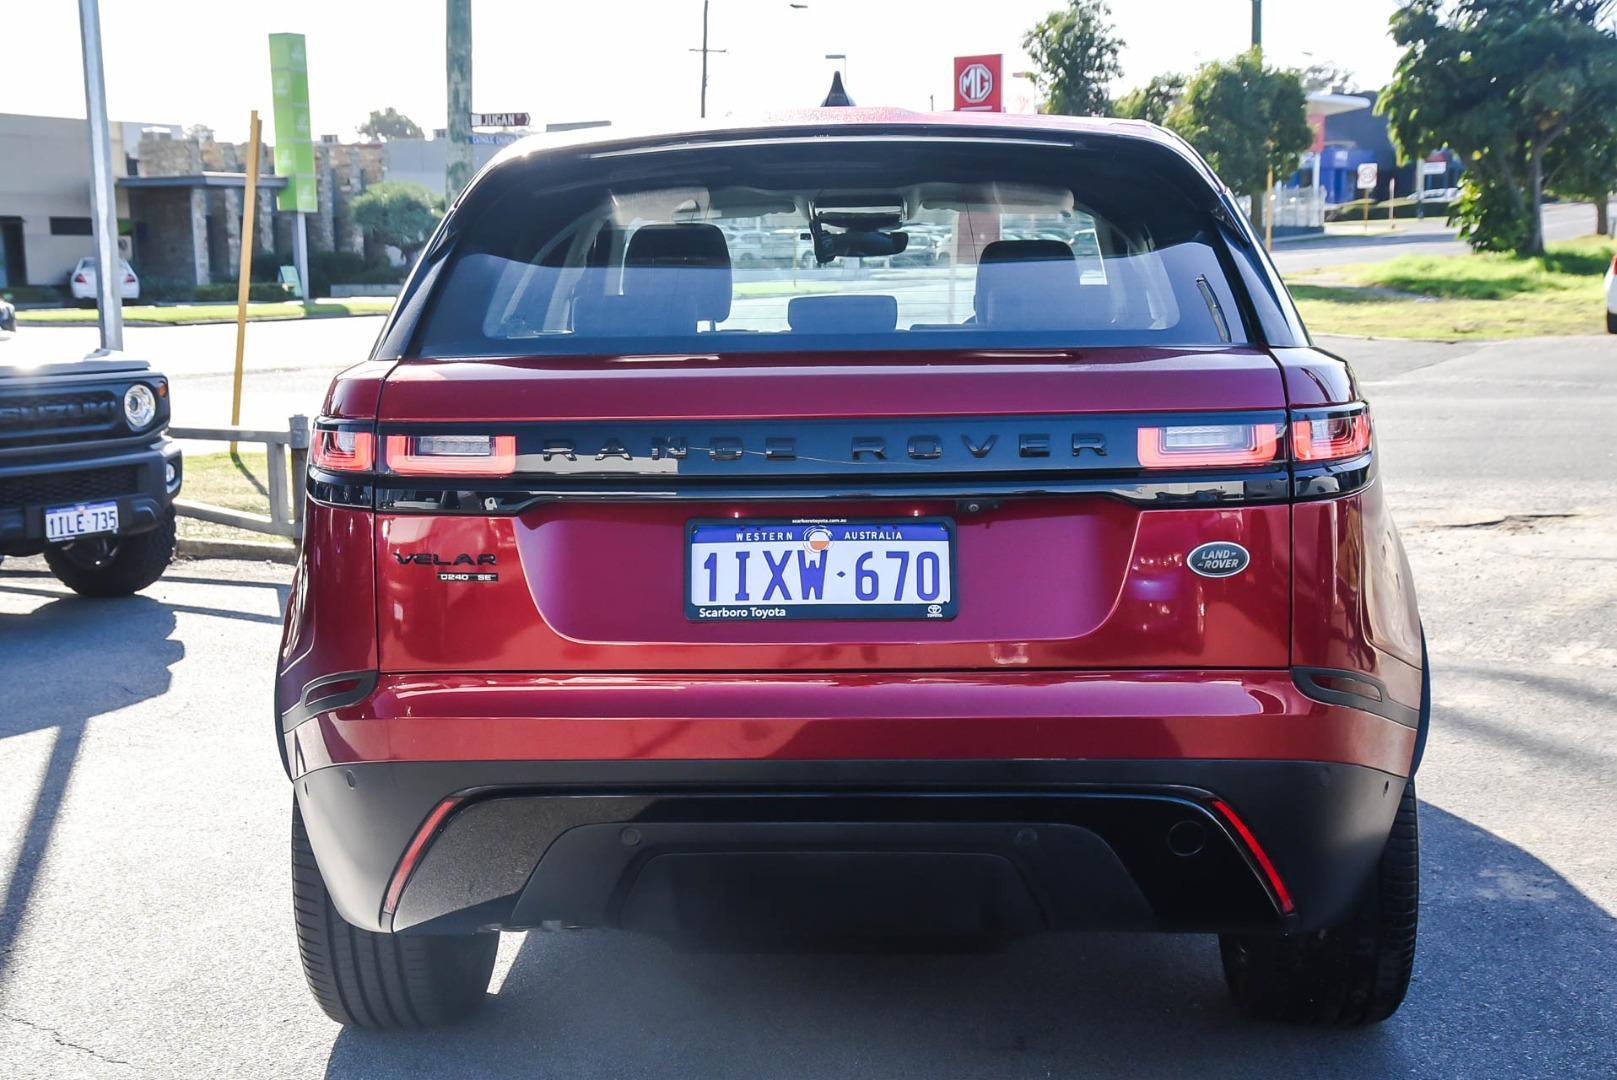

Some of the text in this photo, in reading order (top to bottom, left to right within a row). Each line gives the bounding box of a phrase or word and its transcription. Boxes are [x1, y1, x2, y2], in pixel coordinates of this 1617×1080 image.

[962, 67, 989, 99] MG
[482, 114, 515, 126] JUGAN
[542, 433, 1108, 461] RANGE ROVER
[736, 531, 903, 541] WESTERN AUSTRALIA
[393, 552, 496, 565] VELAR
[1202, 550, 1230, 559] LAND
[1204, 559, 1239, 568] ROVER
[440, 573, 469, 581] D240
[699, 607, 787, 619] Scarboro Toyota
